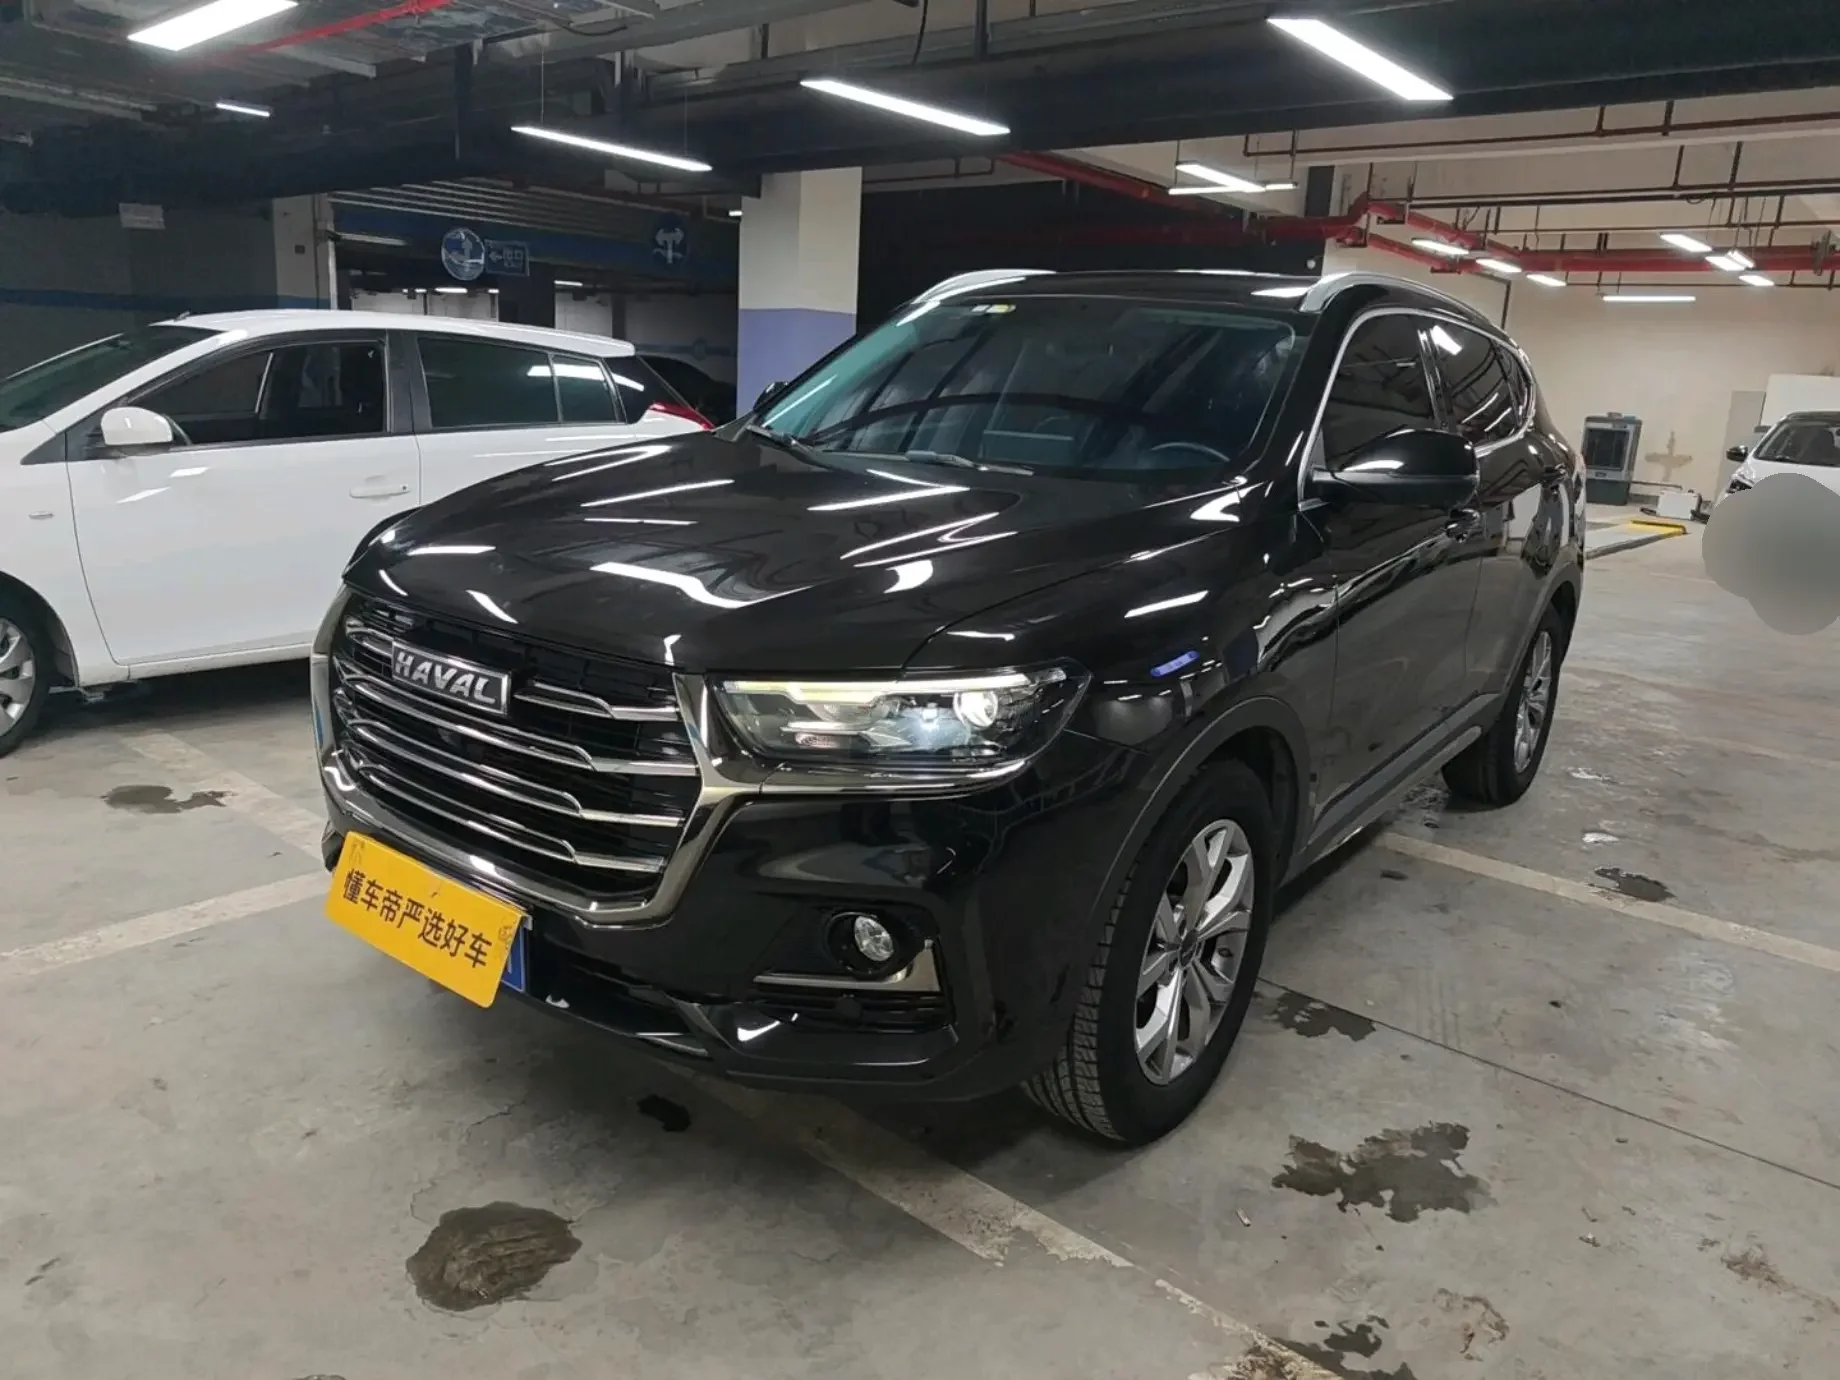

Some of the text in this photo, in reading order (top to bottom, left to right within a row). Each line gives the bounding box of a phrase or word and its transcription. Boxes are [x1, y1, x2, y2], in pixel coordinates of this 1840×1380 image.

[395, 651, 496, 704] HAVAL
[343, 868, 493, 969] 懂车帝严选好车
